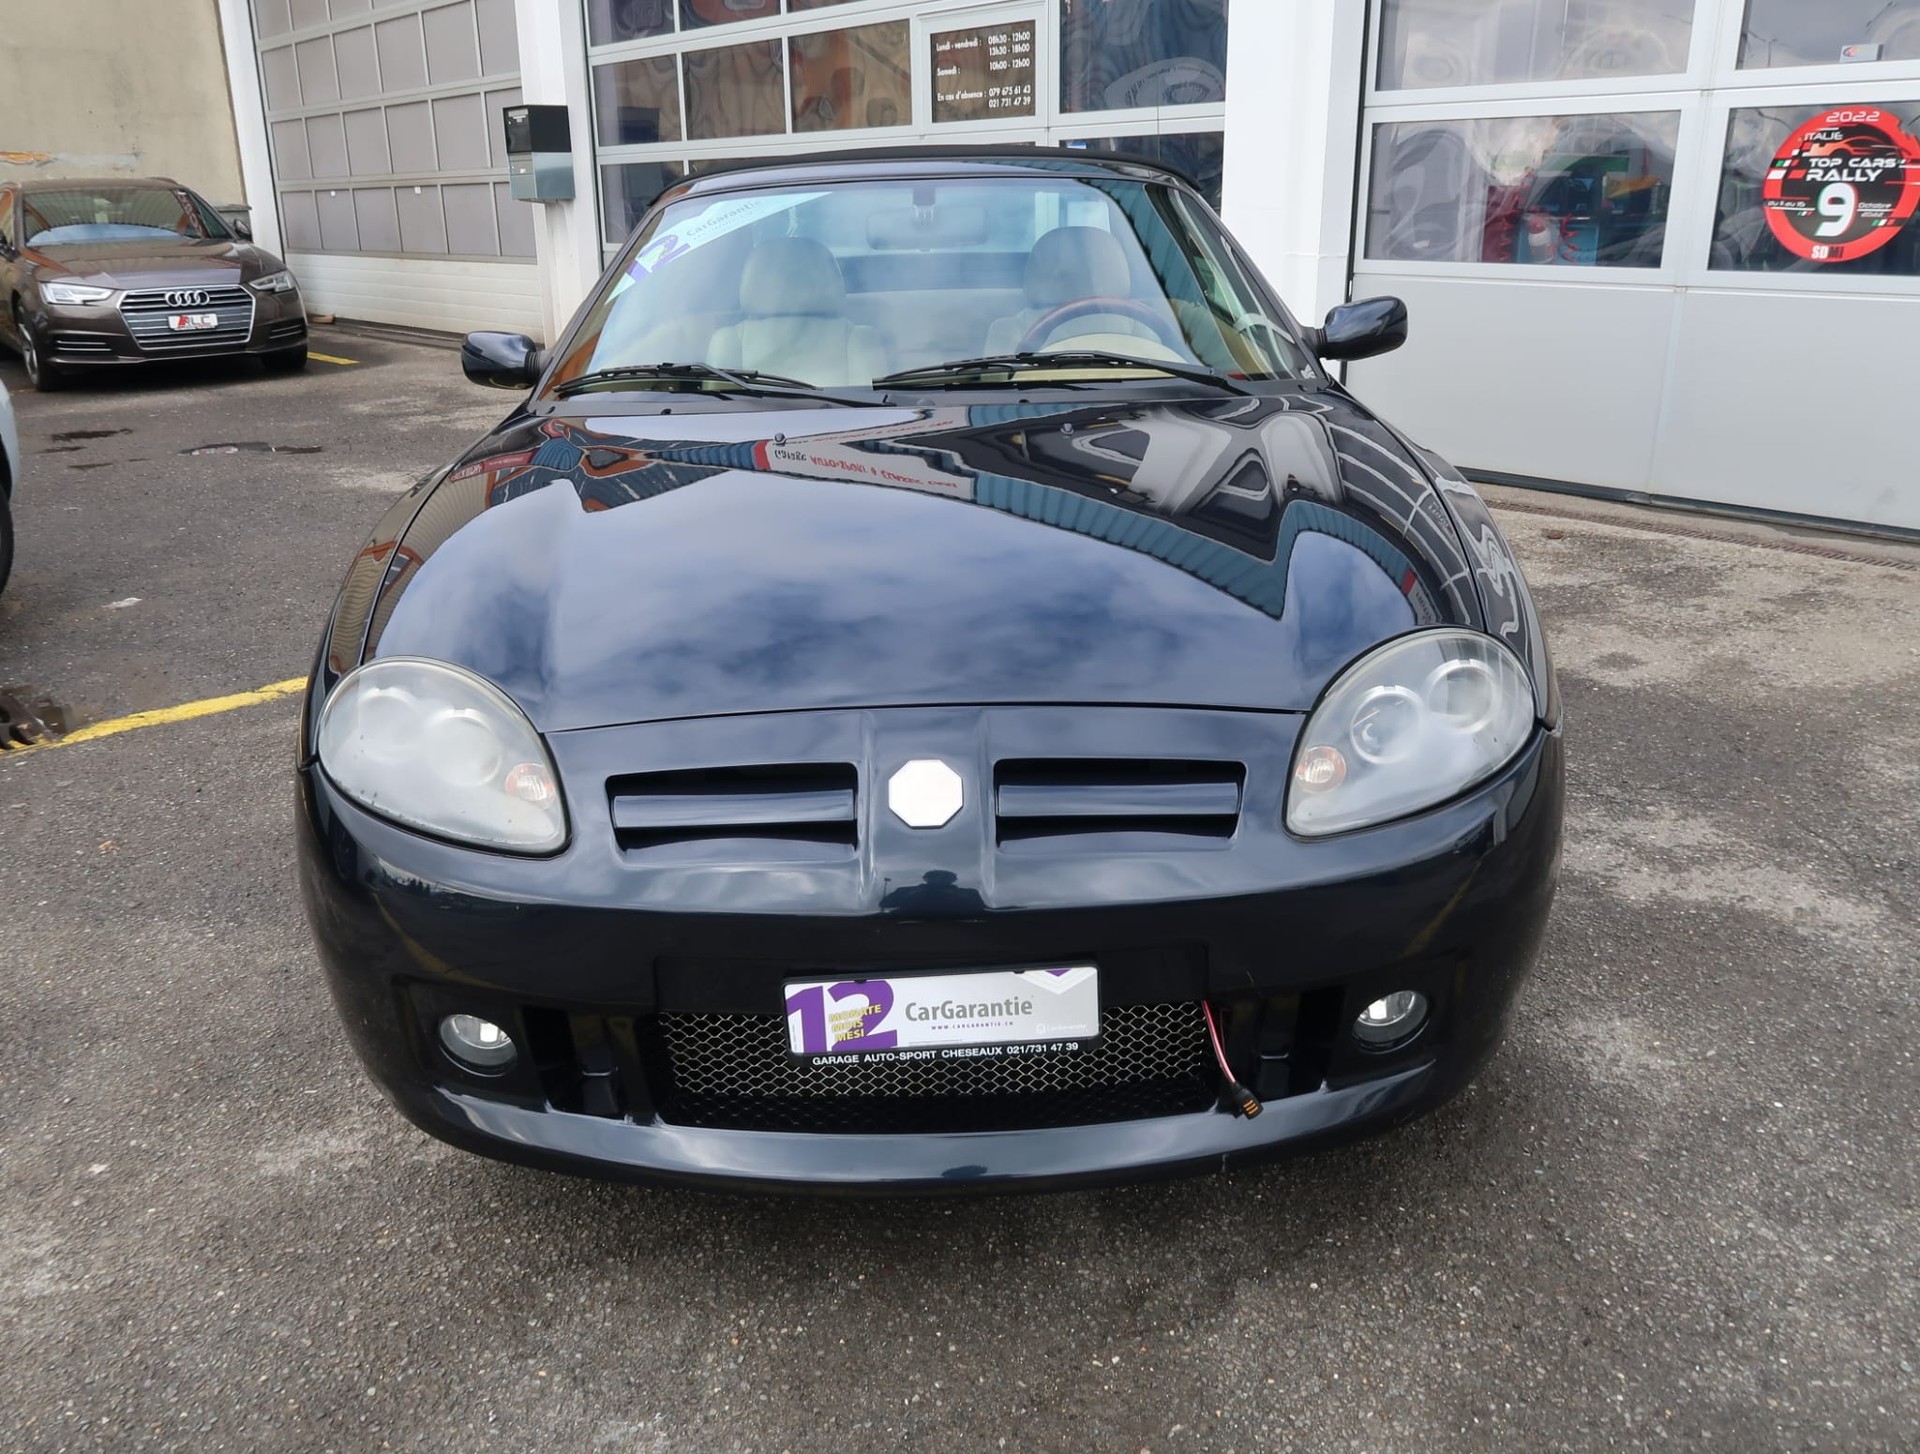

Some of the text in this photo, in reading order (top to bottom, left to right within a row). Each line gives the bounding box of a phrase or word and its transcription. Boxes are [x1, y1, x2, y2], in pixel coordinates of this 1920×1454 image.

[936, 41, 951, 51] Lundi
[955, 37, 978, 49] vendredi
[988, 34, 1007, 45] 08h30
[1012, 31, 1030, 42] 12h00
[989, 46, 1007, 56] 13h30
[1012, 43, 1030, 53] 18h00
[937, 66, 956, 76] Samedi
[989, 61, 1007, 71] 10h00
[1012, 58, 1030, 68] 12h00
[938, 93, 944, 101] En
[955, 90, 983, 100] d'absence
[989, 85, 1031, 97] 079 675 61 43
[989, 96, 1031, 108] 021 731 47 39
[1825, 111, 1880, 123] 2022
[1804, 131, 1844, 141] ITALIE
[1809, 158, 1896, 168] TOP CARS
[1806, 169, 1883, 182] RALLY
[1815, 182, 1857, 237] 9
[785, 979, 898, 1052] 12
[828, 1004, 882, 1022] MONATE
[905, 996, 1033, 1022] CarGarantie
[832, 1019, 864, 1032] MOIS
[835, 1029, 865, 1042] MESI
[812, 1042, 1079, 1066] GARAGE AUTO-SPORT CHESEAUX 021/731 47 39
